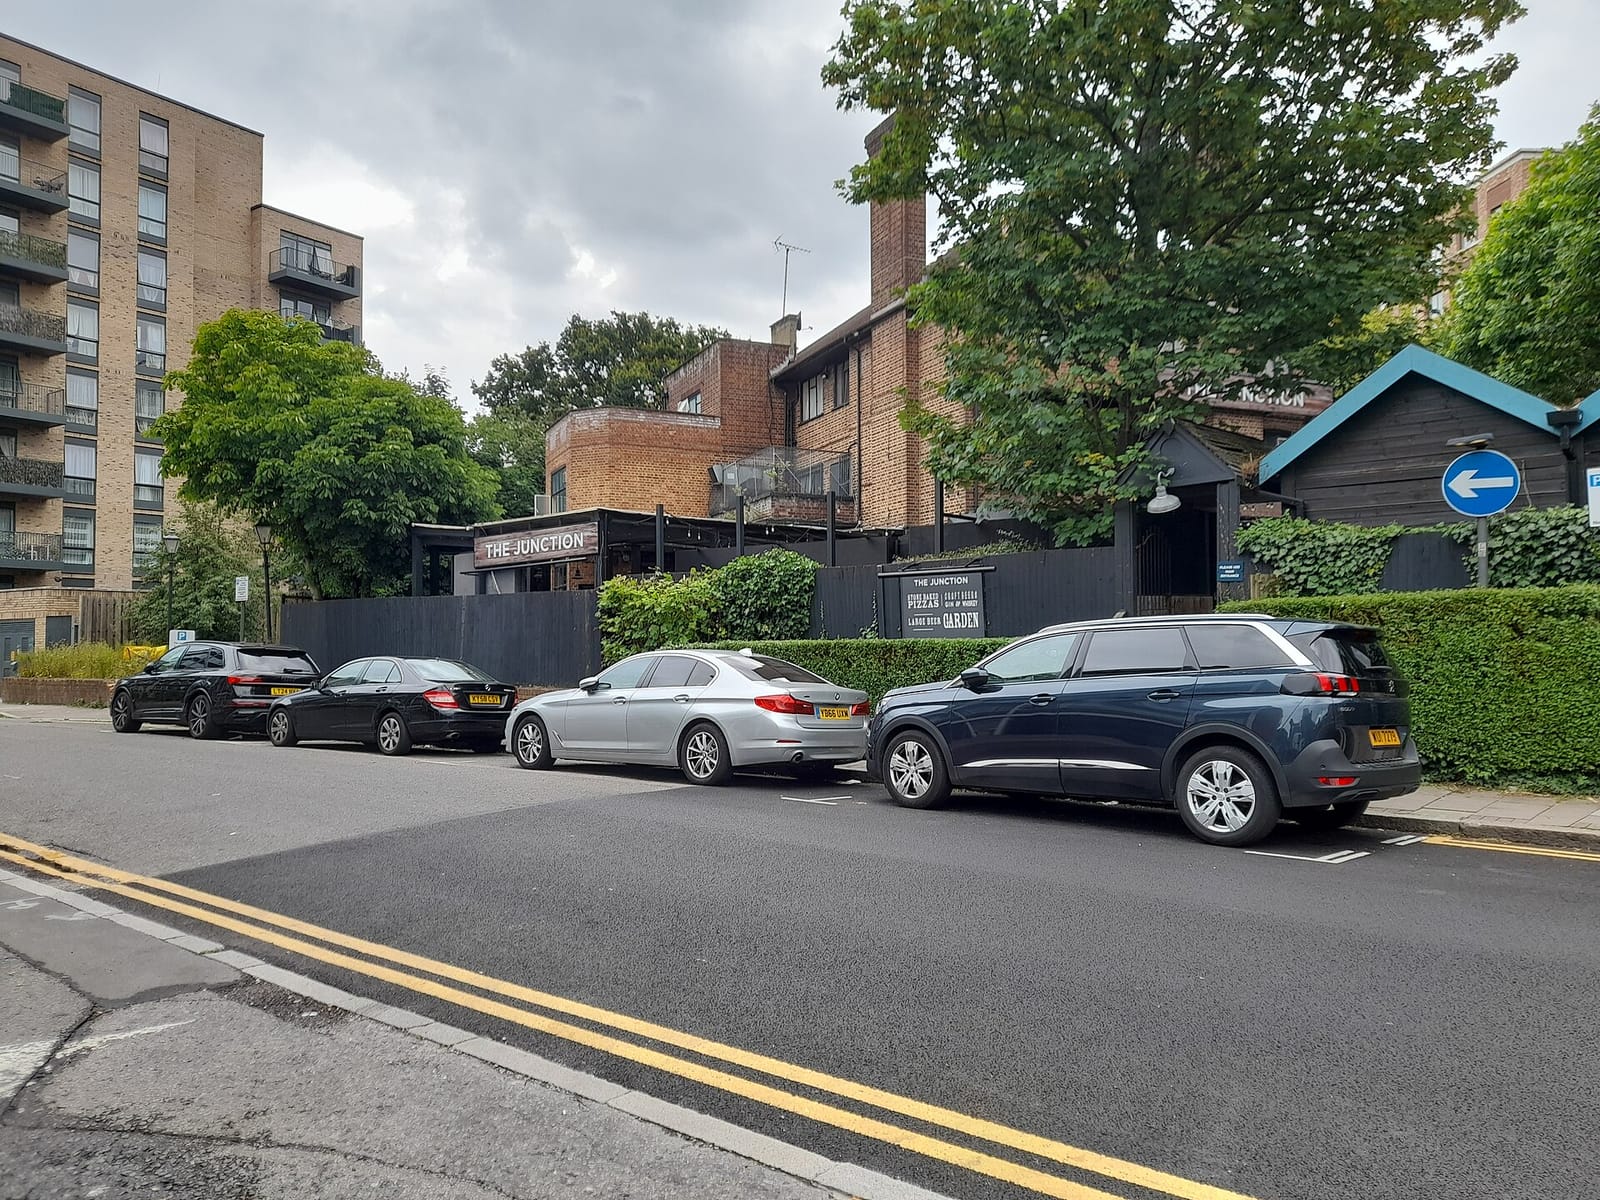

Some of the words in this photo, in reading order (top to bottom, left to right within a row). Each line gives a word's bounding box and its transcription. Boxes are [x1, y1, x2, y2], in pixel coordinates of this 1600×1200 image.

[485, 542, 510, 559] THE
[514, 532, 584, 556] JUNCTION
[914, 578, 928, 587] THE
[930, 576, 969, 586] JUNCTION
[923, 592, 939, 600] BAKED
[907, 600, 939, 609] PIZZAS
[908, 617, 926, 626] LARGE
[943, 612, 979, 629] GARDEN
